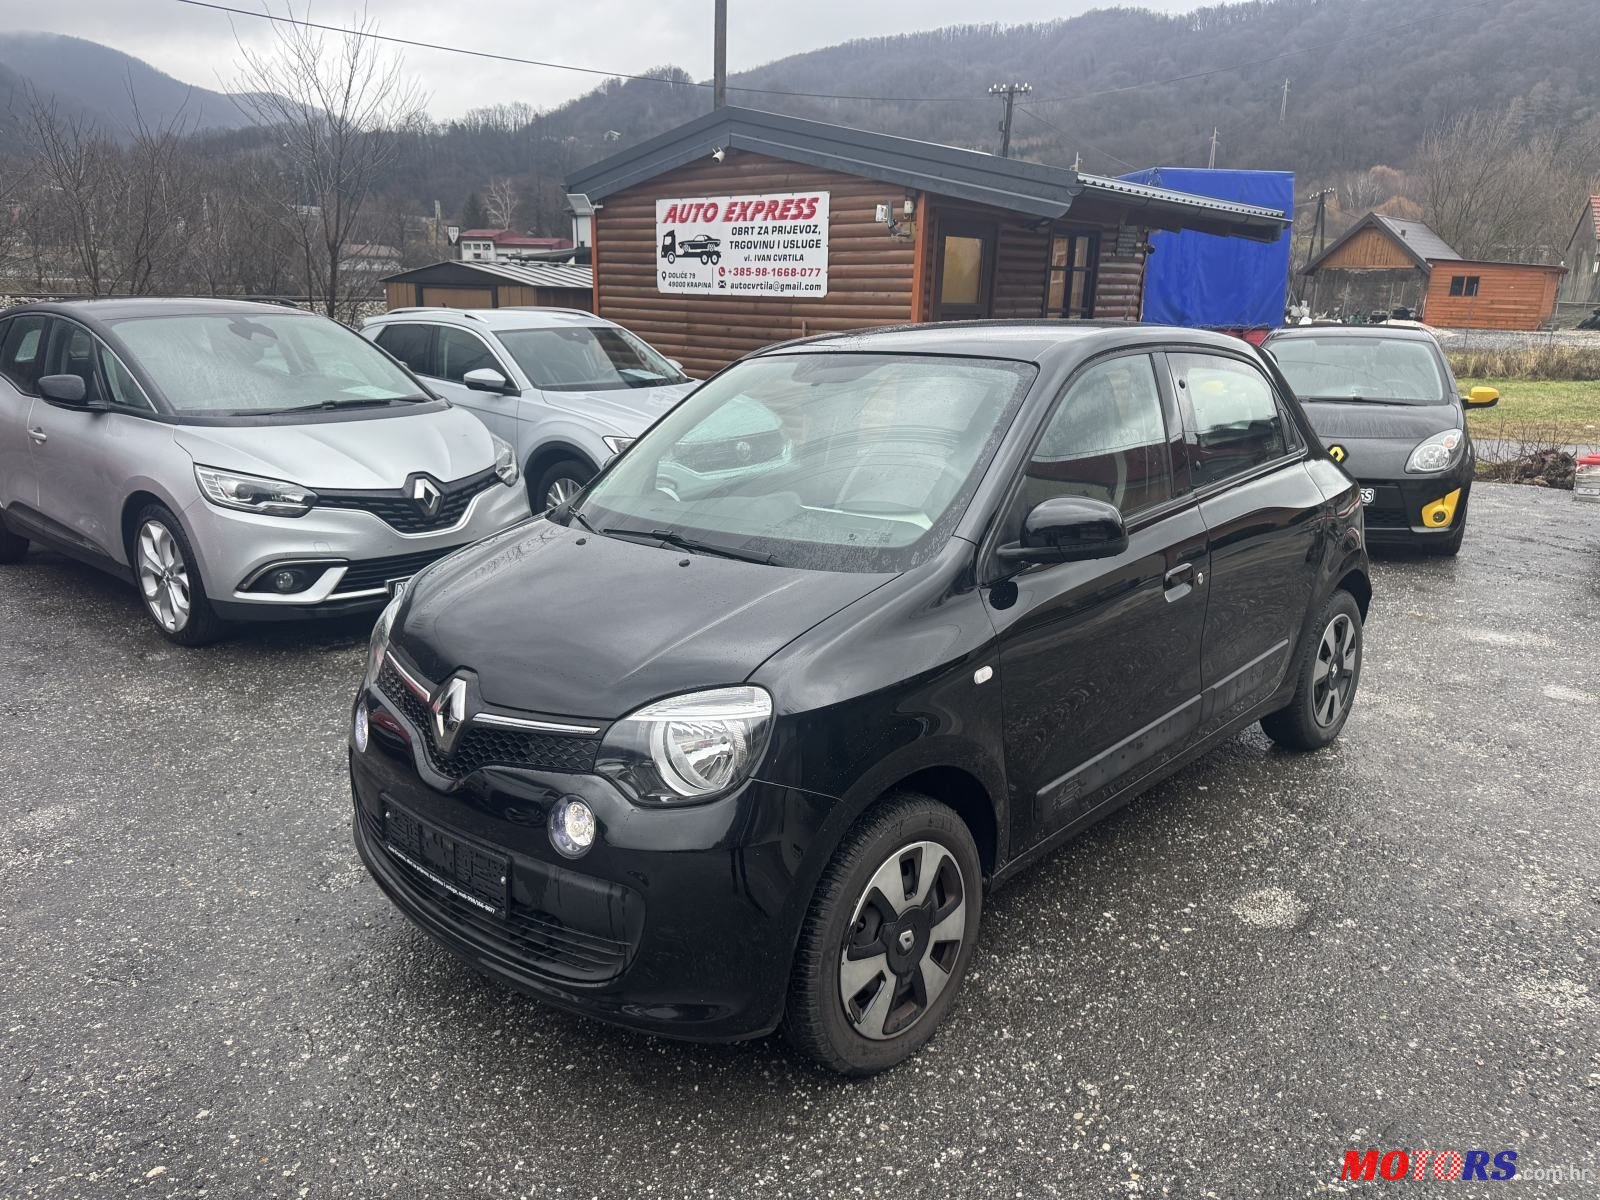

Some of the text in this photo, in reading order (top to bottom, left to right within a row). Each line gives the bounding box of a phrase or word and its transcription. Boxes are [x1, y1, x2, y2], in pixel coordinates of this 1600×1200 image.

[663, 197, 820, 223] AUTO EXPRESS
[731, 224, 821, 236] OBRT ZA PRIJEVOZ,
[729, 239, 822, 250] TRGOVINU I USLUGE
[754, 254, 772, 262] IVAN
[773, 253, 804, 262] CVRTILA
[728, 267, 822, 277] +385-98-1668-077
[730, 281, 822, 292] autocvrtila@gmail.com
